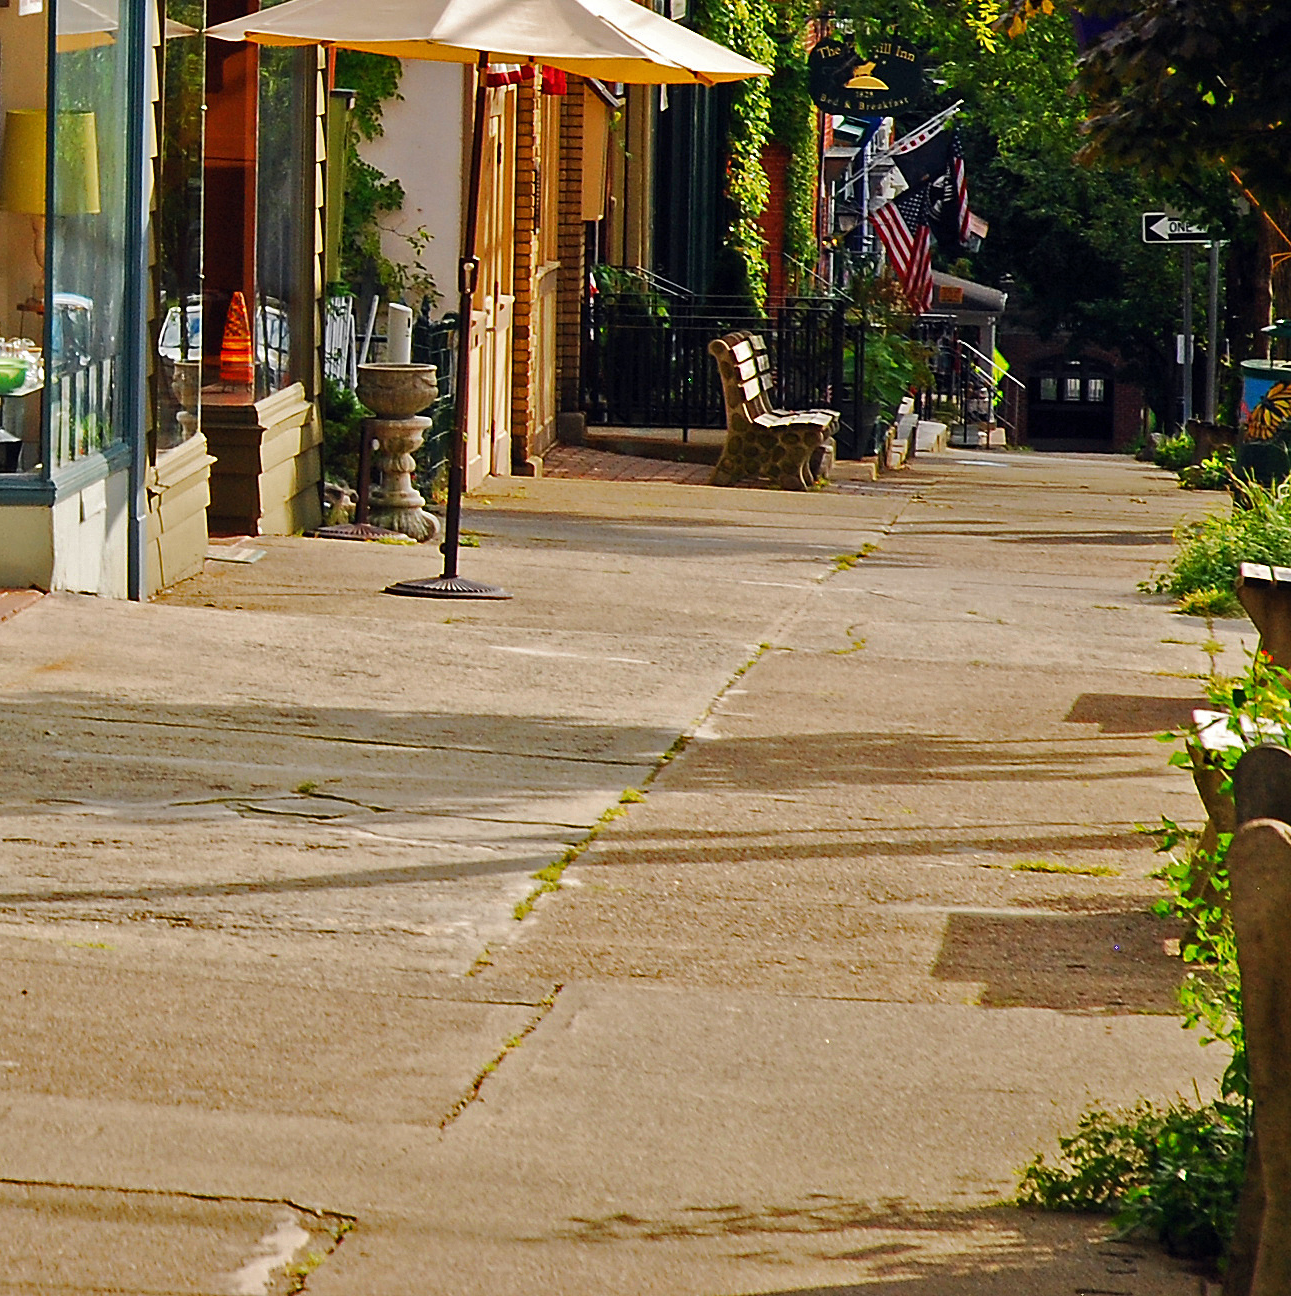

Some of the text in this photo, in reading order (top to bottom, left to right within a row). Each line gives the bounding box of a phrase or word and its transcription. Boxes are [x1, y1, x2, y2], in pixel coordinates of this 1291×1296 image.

[817, 45, 841, 59] The
[896, 46, 915, 62] Inn
[820, 93, 909, 111] Bed & Breakfast
[1169, 222, 1193, 233] ONE
